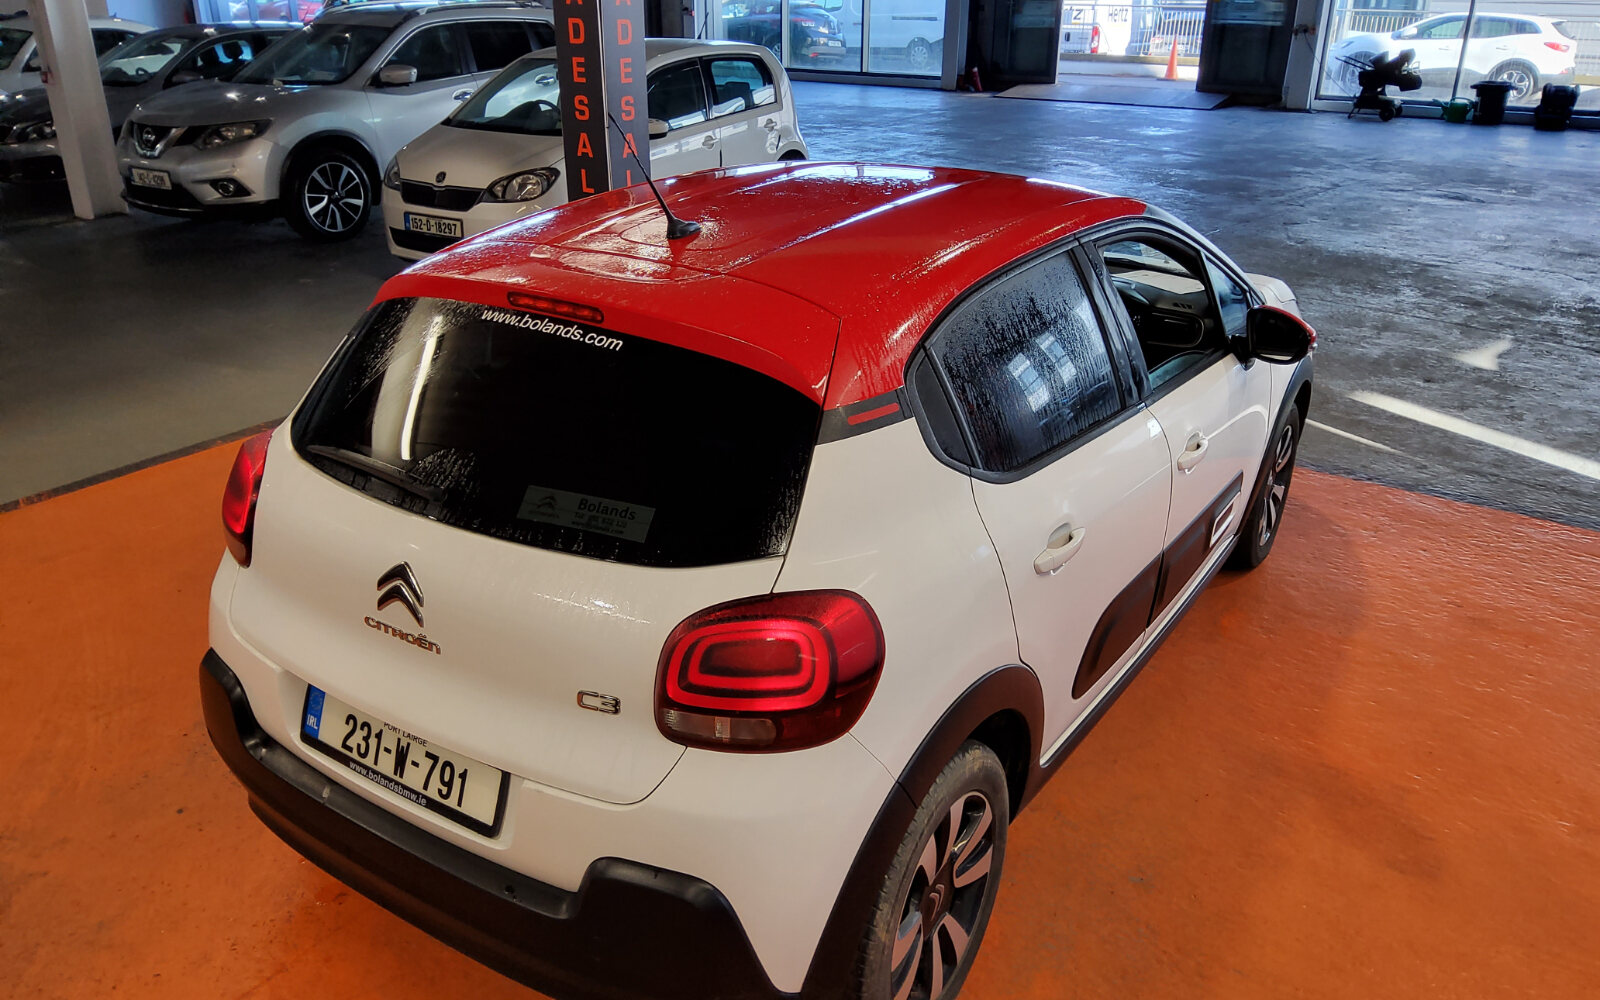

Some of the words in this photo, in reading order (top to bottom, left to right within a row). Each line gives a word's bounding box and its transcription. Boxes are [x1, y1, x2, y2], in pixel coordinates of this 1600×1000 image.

[565, 0, 595, 194] DESAL
[411, 217, 457, 236] 152-D-18297
[481, 309, 624, 351] www.bolands.com
[577, 498, 637, 521] Bolands
[577, 690, 621, 715] C3
[306, 714, 319, 730] IRL
[402, 730, 429, 747] LAIRGE
[341, 713, 469, 808] 231-W-791
[349, 760, 428, 806] www.bolandsbmw.ie
